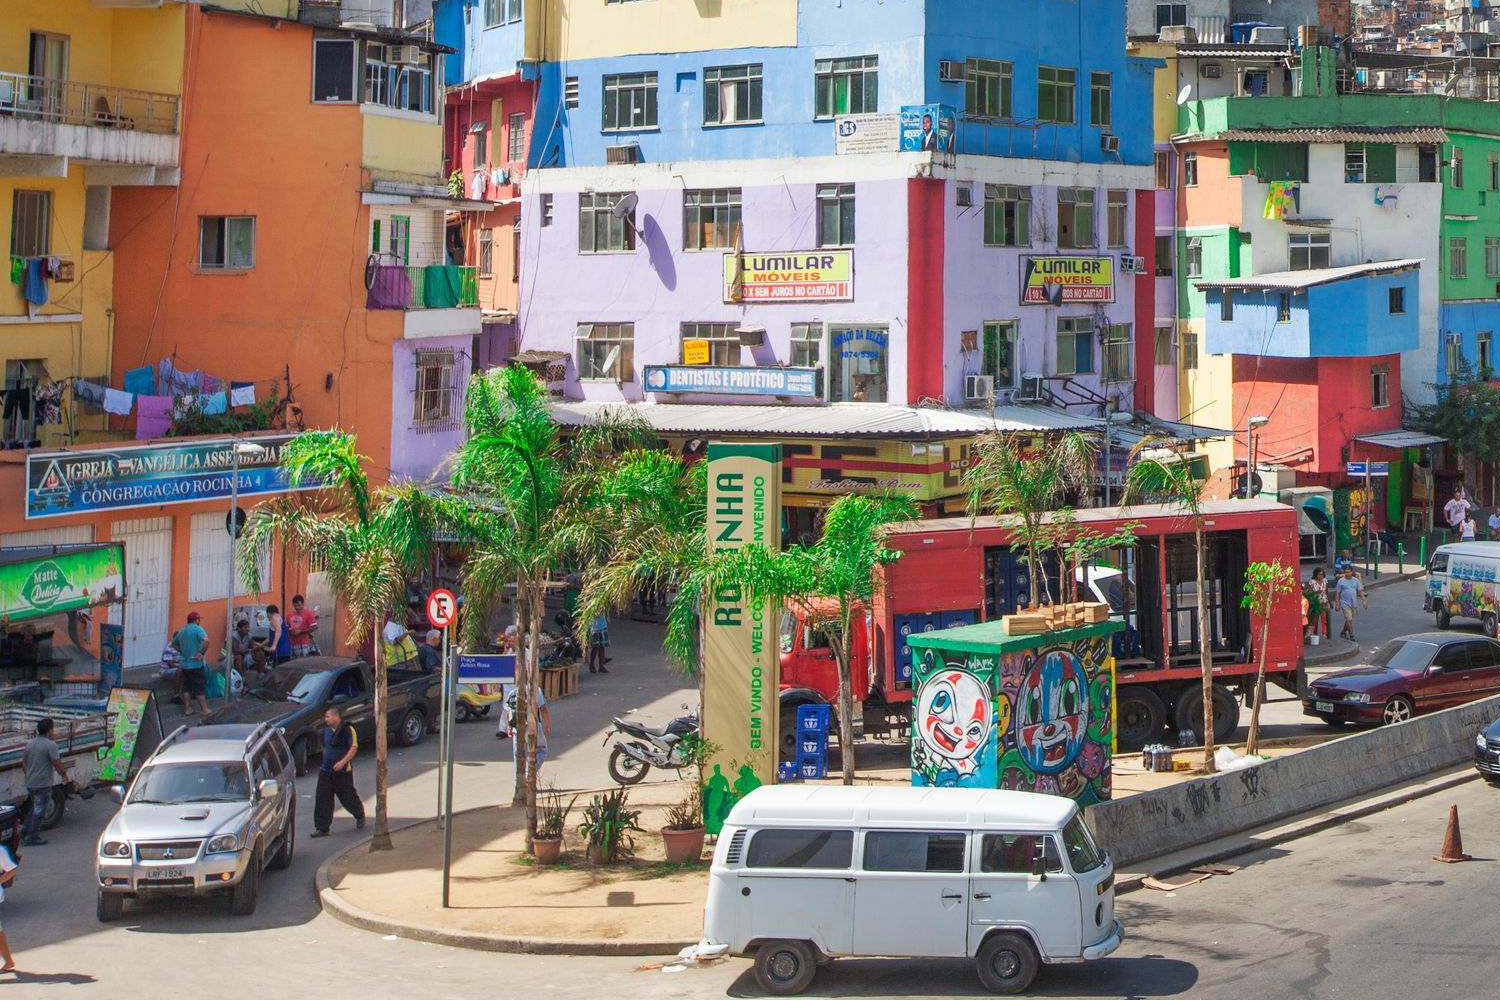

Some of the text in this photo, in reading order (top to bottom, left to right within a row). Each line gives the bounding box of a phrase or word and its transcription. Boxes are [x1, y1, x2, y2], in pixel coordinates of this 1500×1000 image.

[741, 255, 835, 271] LUMILAR
[1034, 260, 1101, 274] LUMILAR
[753, 271, 821, 282] MÓVEIS
[1043, 274, 1093, 284] MÓVEIS
[755, 287, 769, 297] SEM
[771, 286, 793, 296] JUROS
[795, 286, 805, 296] NO
[807, 284, 836, 296] CARTÃO
[669, 370, 722, 387] DENTISTAS
[723, 372, 729, 387] E
[730, 370, 785, 389] PROTÉTICO
[65, 458, 113, 482] IGREJA
[81, 477, 191, 505] CONGREGAÇÃO
[192, 474, 253, 495] ROCINHA
[254, 476, 262, 488] 4
[714, 473, 744, 627] ROINHA
[33, 570, 58, 585] Matte
[436, 597, 448, 619] E
[751, 666, 763, 713] VINDO
[750, 717, 762, 749] BEM
